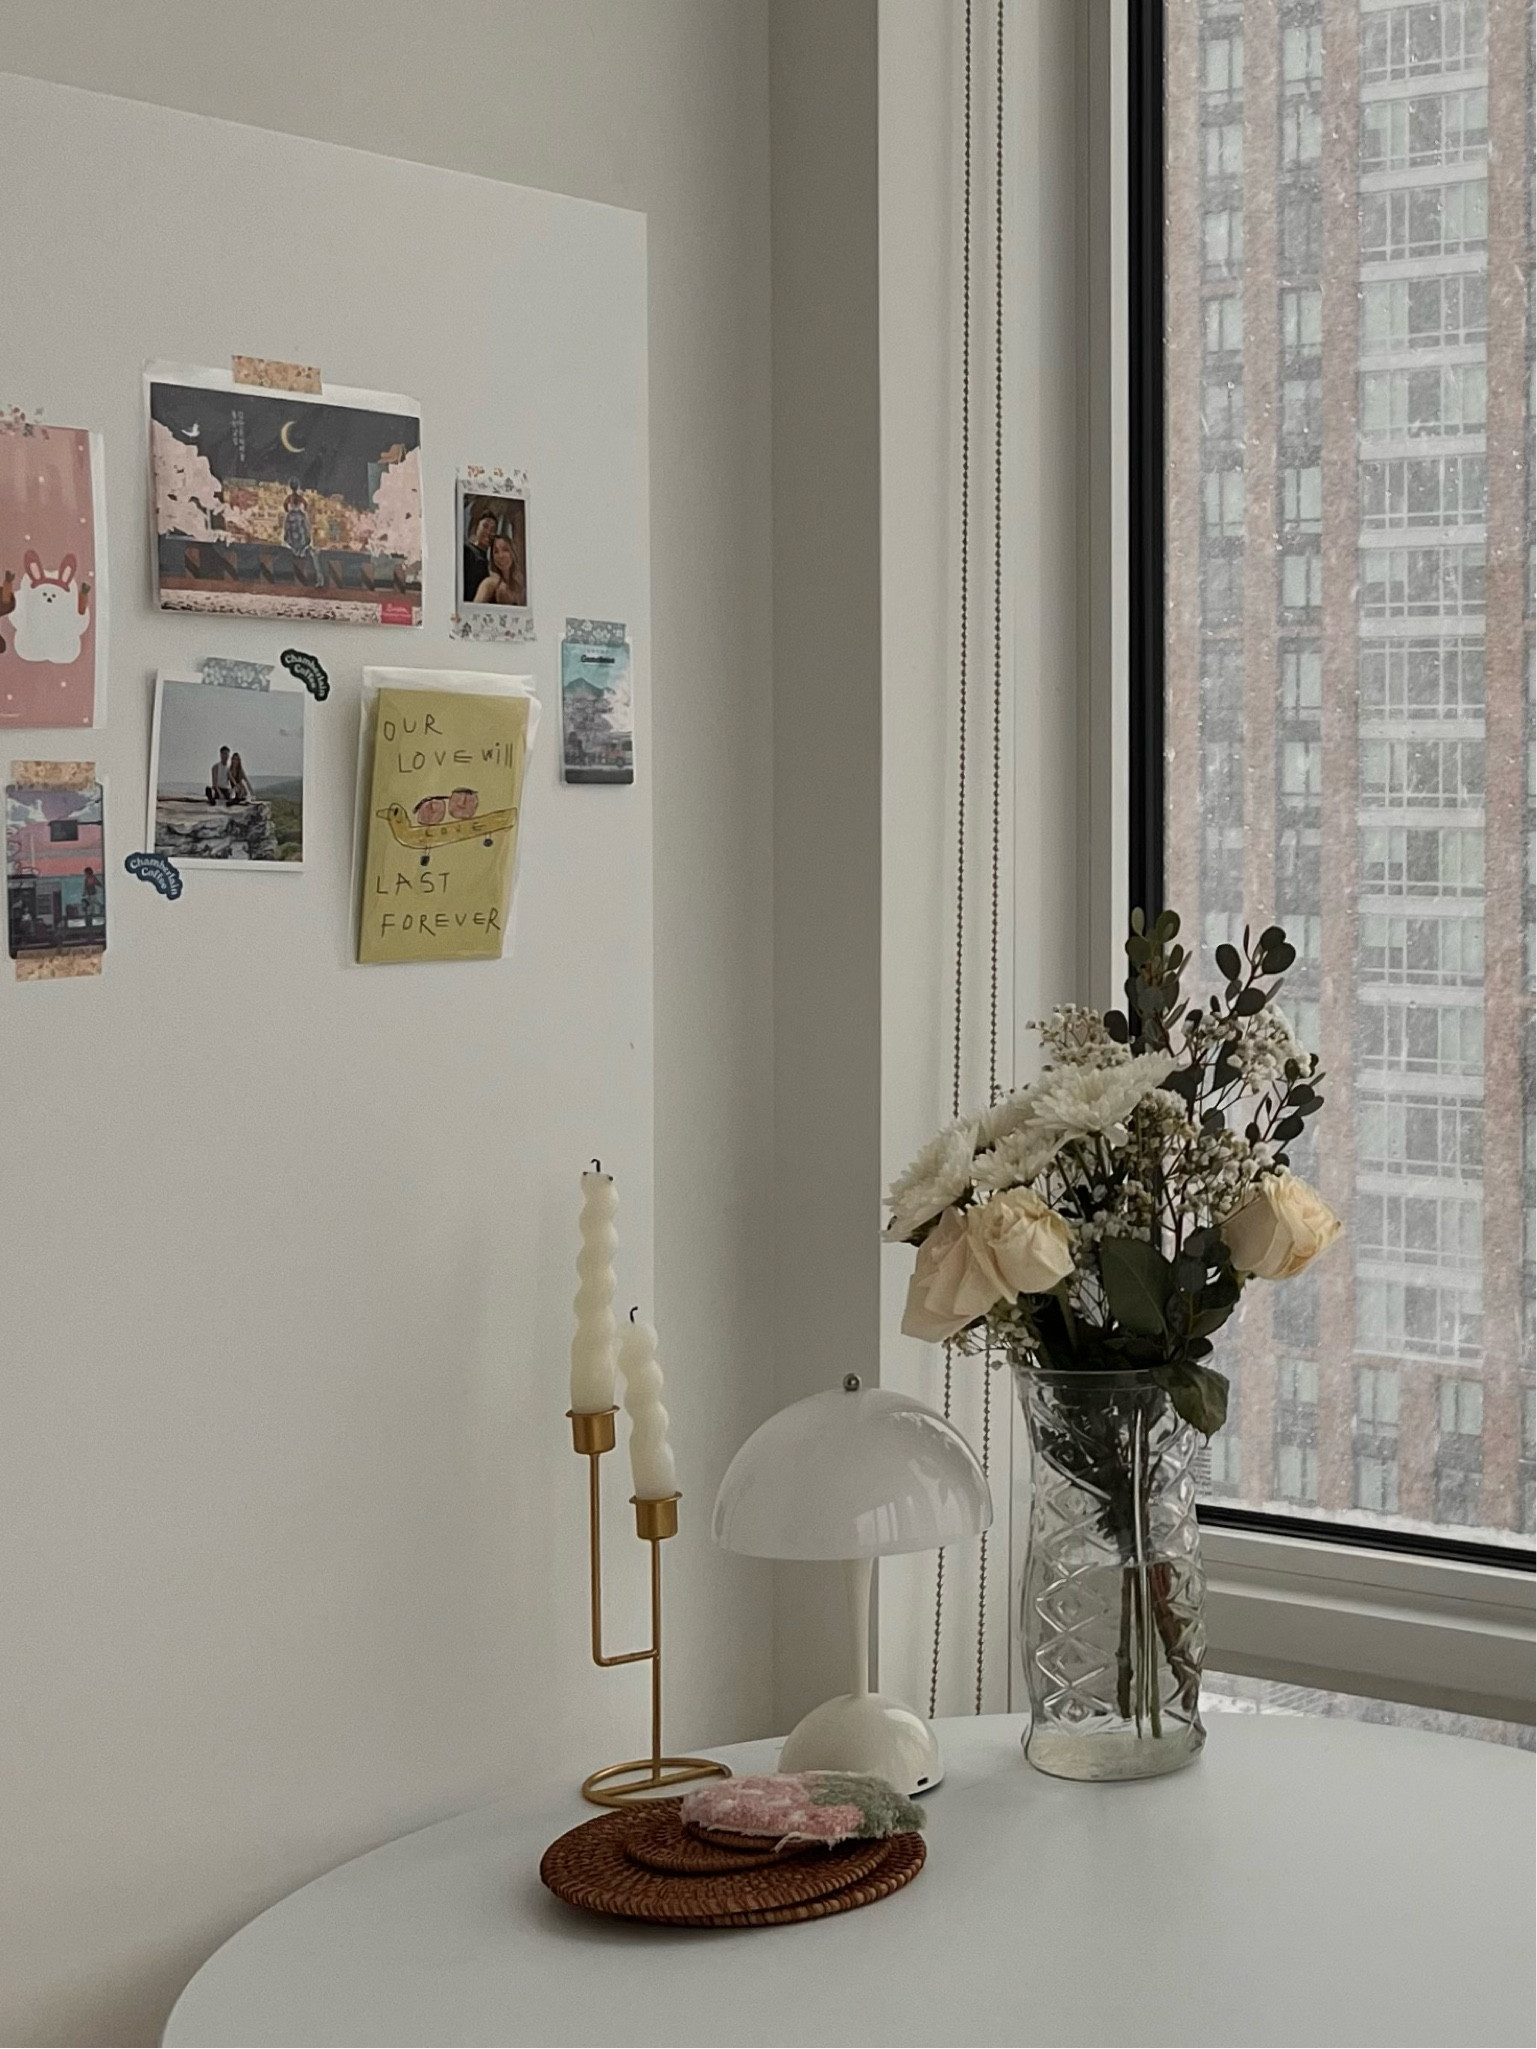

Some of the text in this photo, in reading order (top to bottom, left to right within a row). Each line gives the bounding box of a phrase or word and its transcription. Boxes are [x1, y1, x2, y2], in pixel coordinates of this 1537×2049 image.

[284, 654, 327, 697] Chamberlain
[294, 663, 316, 689] Coffee
[383, 713, 443, 741] OUR
[398, 742, 514, 773] LOVE will
[130, 857, 180, 895] Chamberlain
[141, 867, 167, 890] Coffee
[376, 871, 450, 894] LAST
[381, 907, 501, 938] FOREVER
